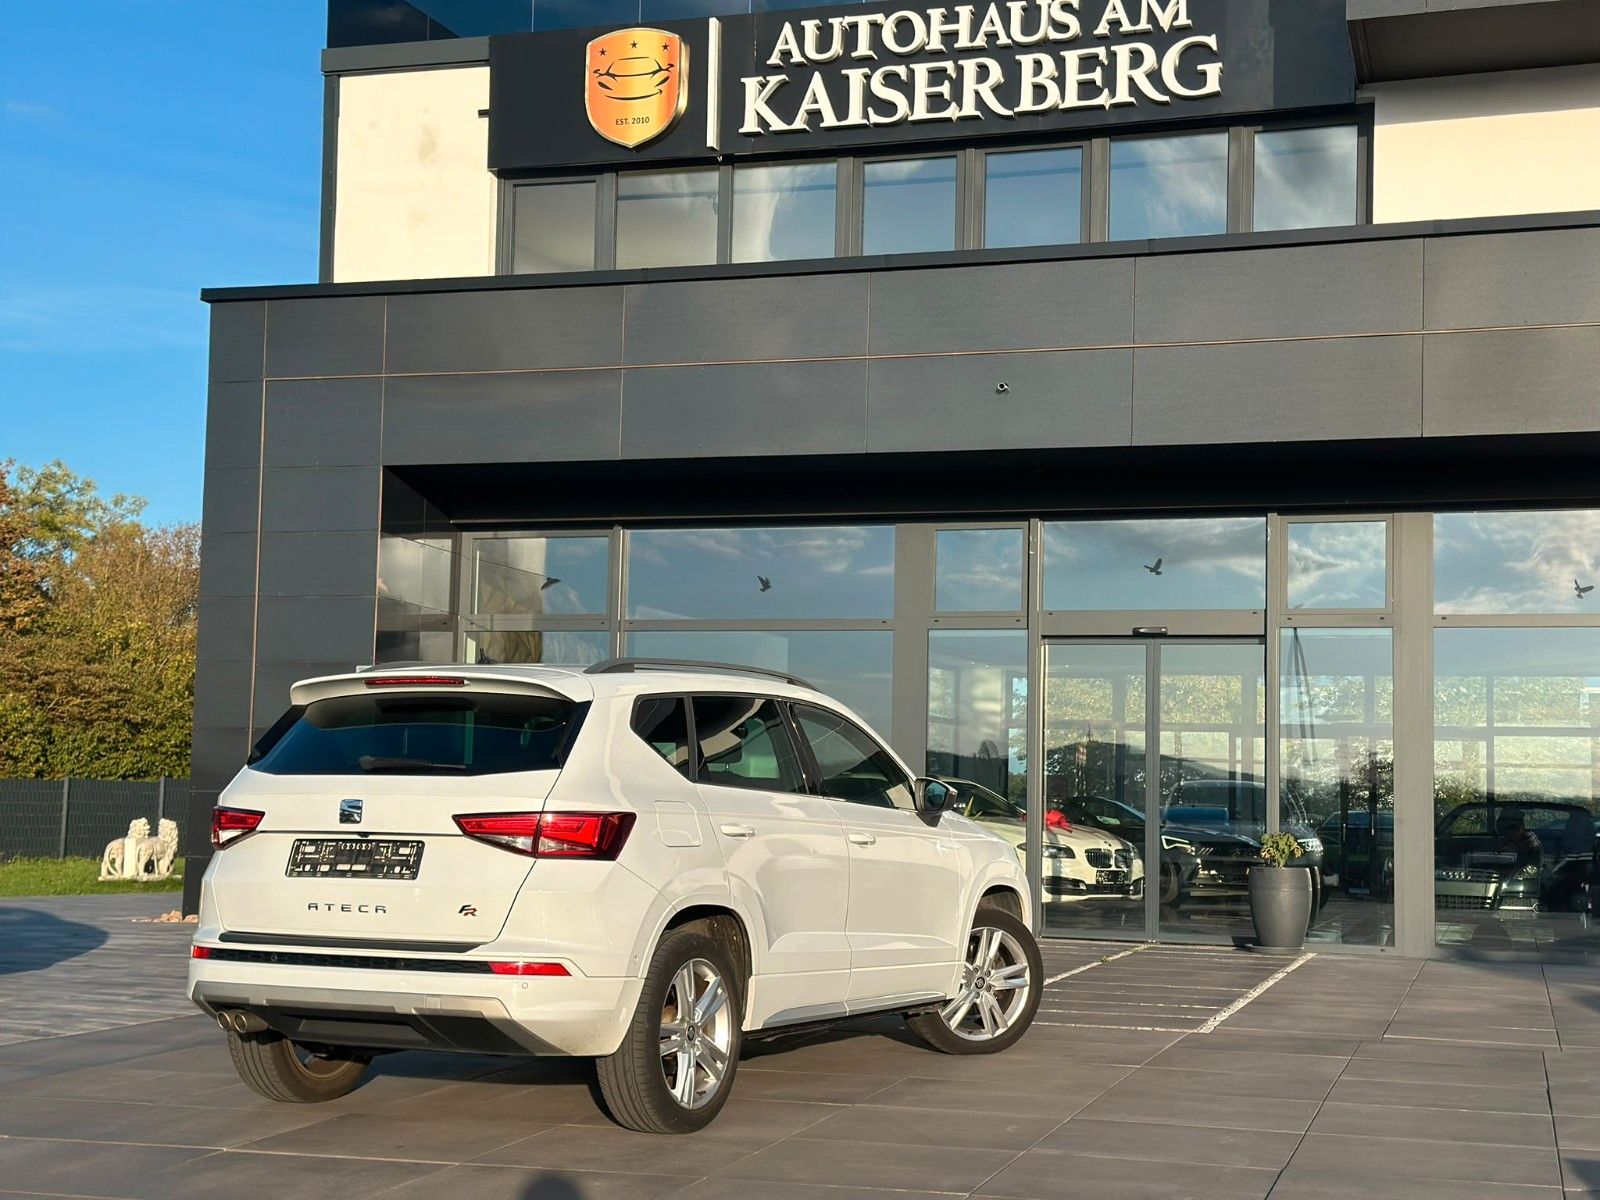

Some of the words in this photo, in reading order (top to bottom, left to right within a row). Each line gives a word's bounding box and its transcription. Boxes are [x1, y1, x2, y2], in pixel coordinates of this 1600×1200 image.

[766, 0, 1082, 67] AUTOHAUS
[1093, 0, 1193, 38] AM
[738, 33, 1223, 135] KAISERBERG
[615, 118, 630, 126] EST.
[631, 116, 650, 125] 2010
[307, 902, 387, 914] ATECA
[458, 904, 477, 917] FR
